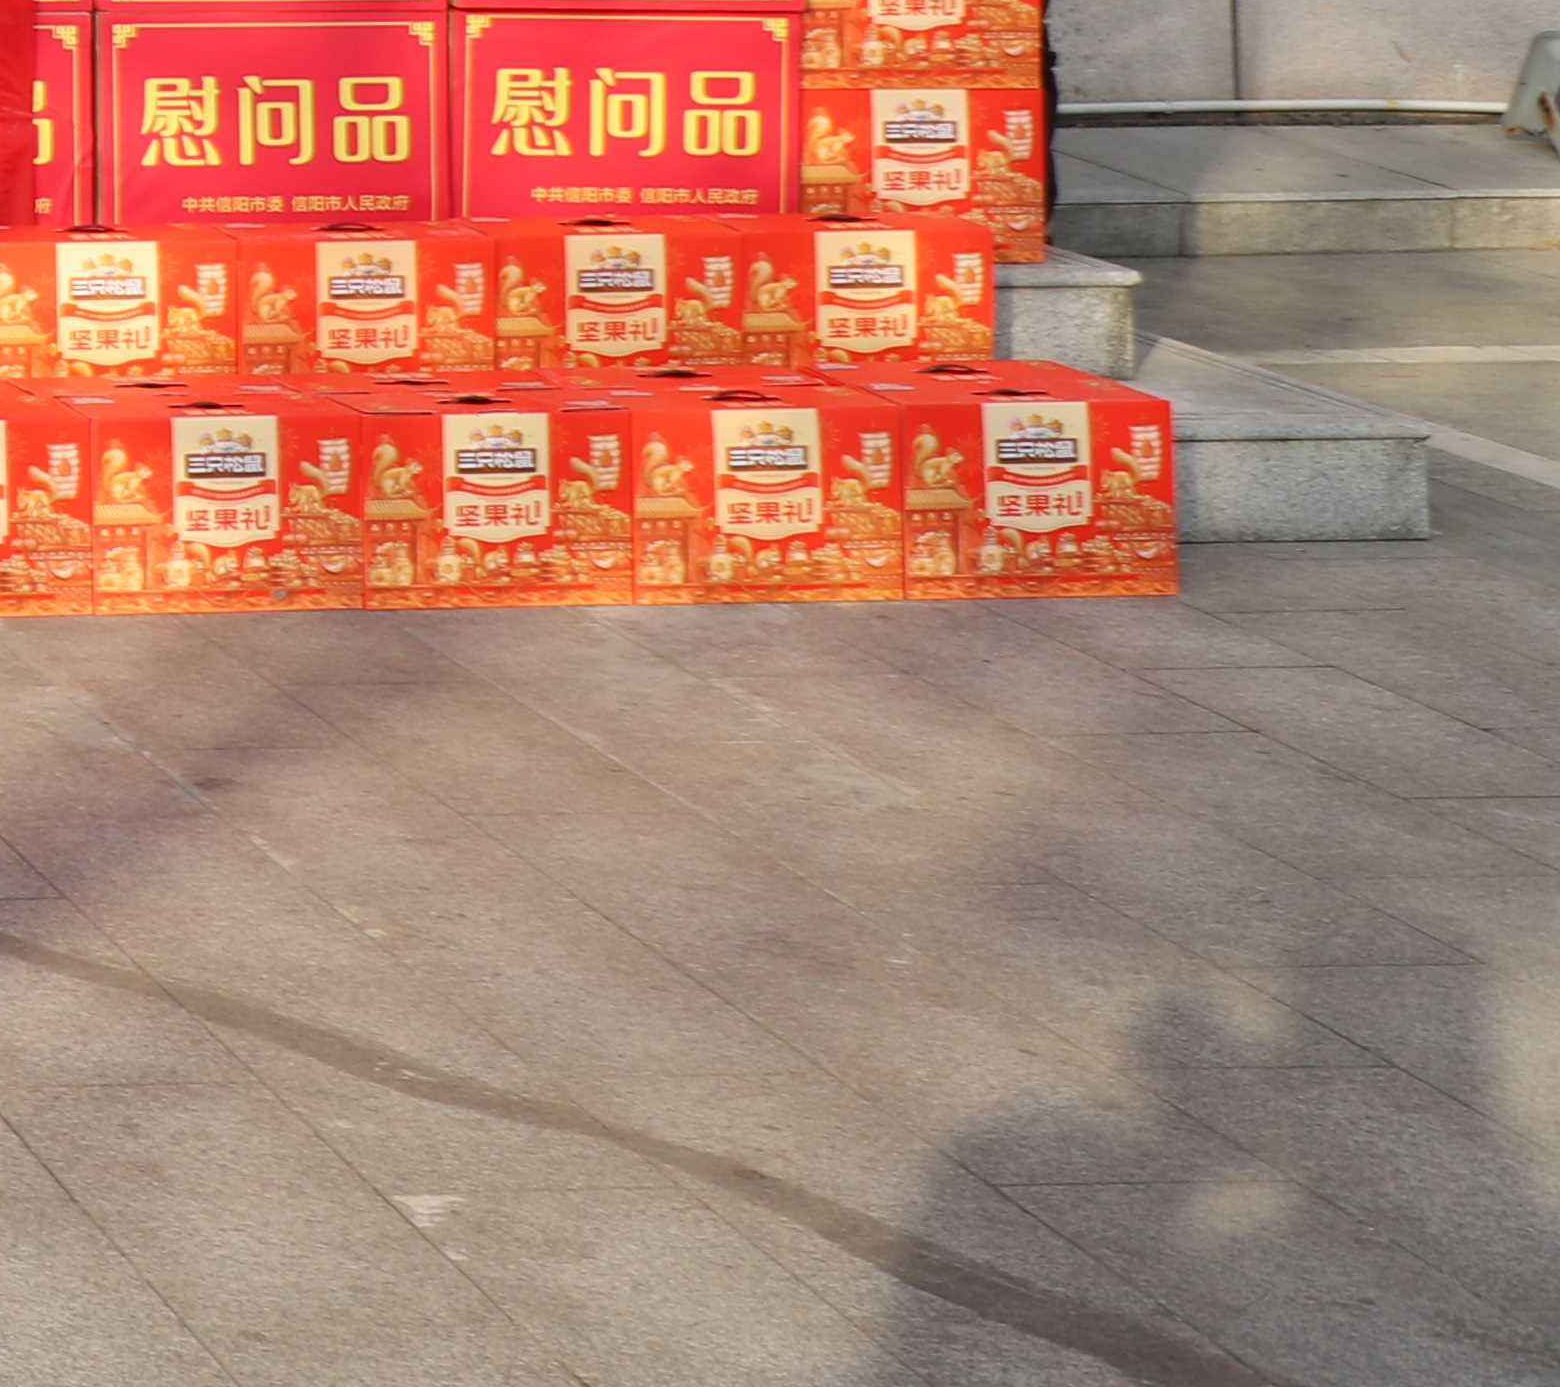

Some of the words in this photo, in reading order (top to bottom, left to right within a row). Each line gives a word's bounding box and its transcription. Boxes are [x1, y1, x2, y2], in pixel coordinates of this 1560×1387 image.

[140, 75, 411, 167] 慰问品
[491, 67, 762, 157] 慰问品
[181, 195, 284, 213] 中共信阳市委
[290, 195, 409, 213] 信阳市人民政府
[530, 186, 633, 204] 中共信阳市委
[640, 186, 759, 205] 信阳市人民政府
[71, 279, 145, 296] 三只松鼠
[577, 321, 657, 342] 坚果礼
[827, 317, 907, 338] 坚果礼
[68, 329, 150, 350] 坚果礼
[328, 328, 408, 349] 坚果礼
[455, 504, 540, 526] 坚果礼
[728, 502, 811, 524] 坚果礼
[997, 494, 1082, 516] 坚果礼
[186, 509, 269, 531] 坚果礼
